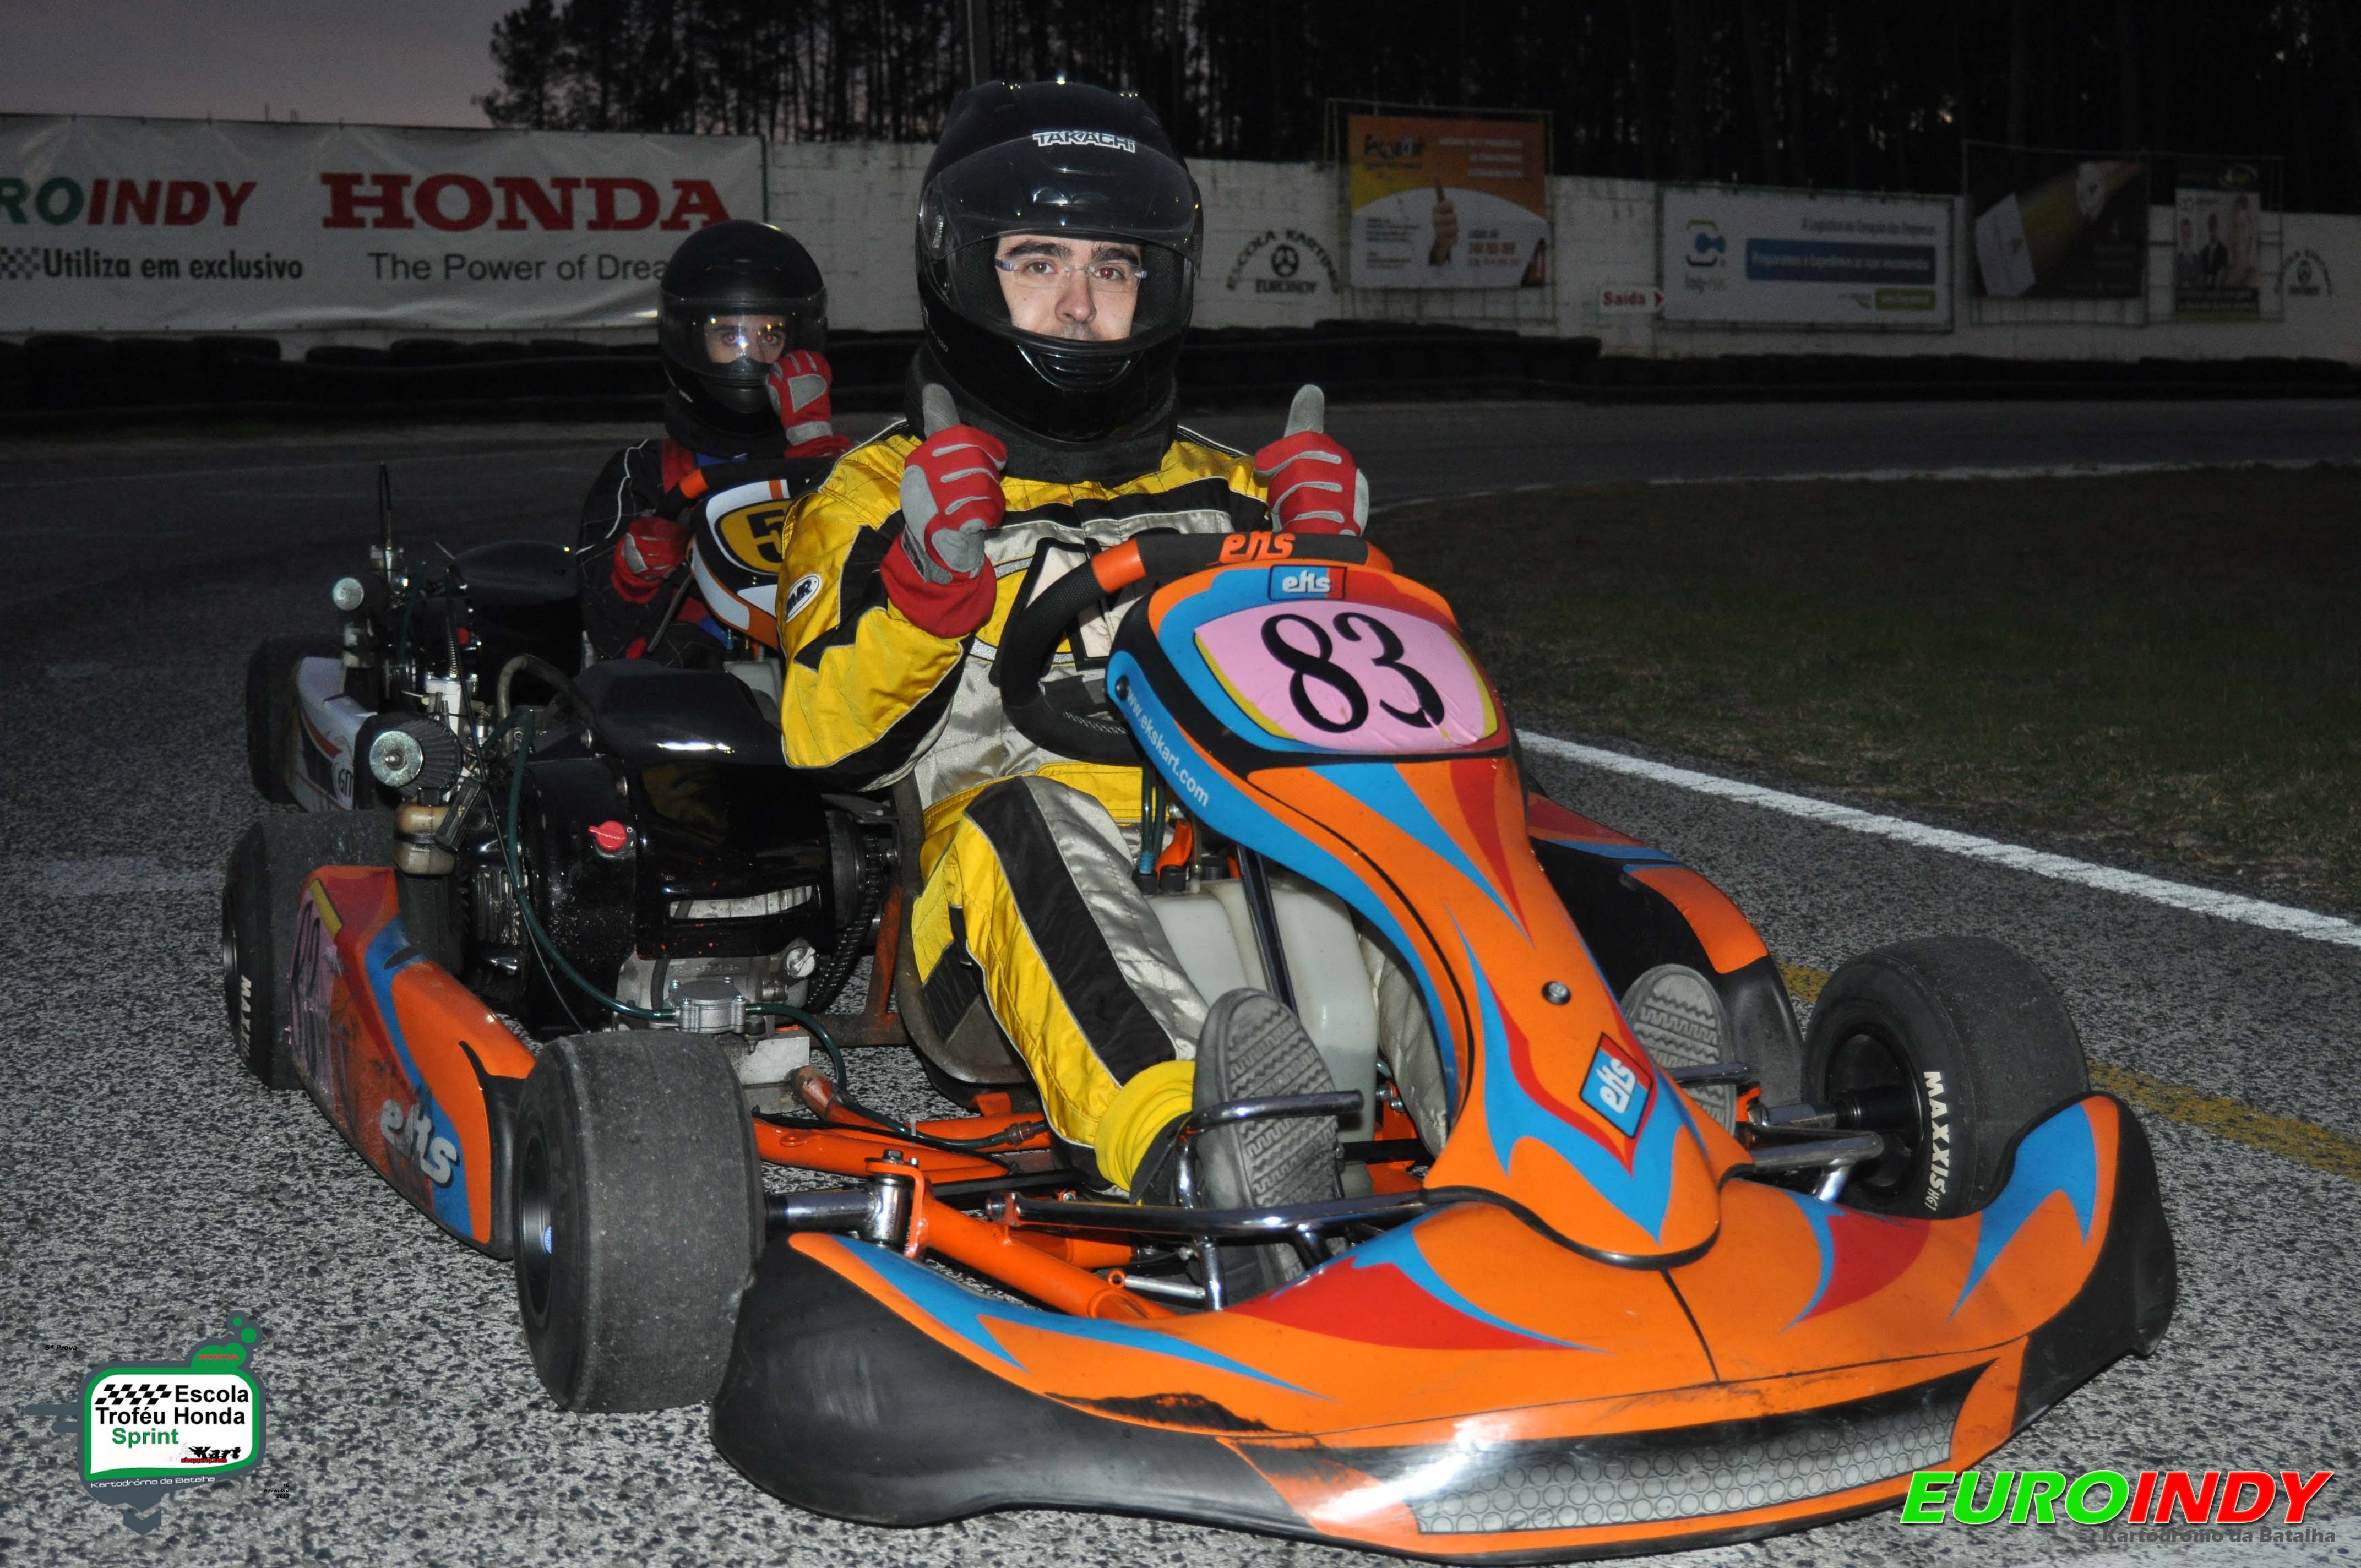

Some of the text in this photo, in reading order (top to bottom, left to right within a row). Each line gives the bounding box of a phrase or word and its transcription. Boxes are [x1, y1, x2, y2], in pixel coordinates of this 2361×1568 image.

[320, 172, 732, 232] HONDA
[43, 248, 303, 280] Utiliza em exclusivo
[367, 252, 667, 281] The Power of Drea
[1261, 612, 1445, 733] 83
[1923, 1071, 1950, 1194] MAXXIS
